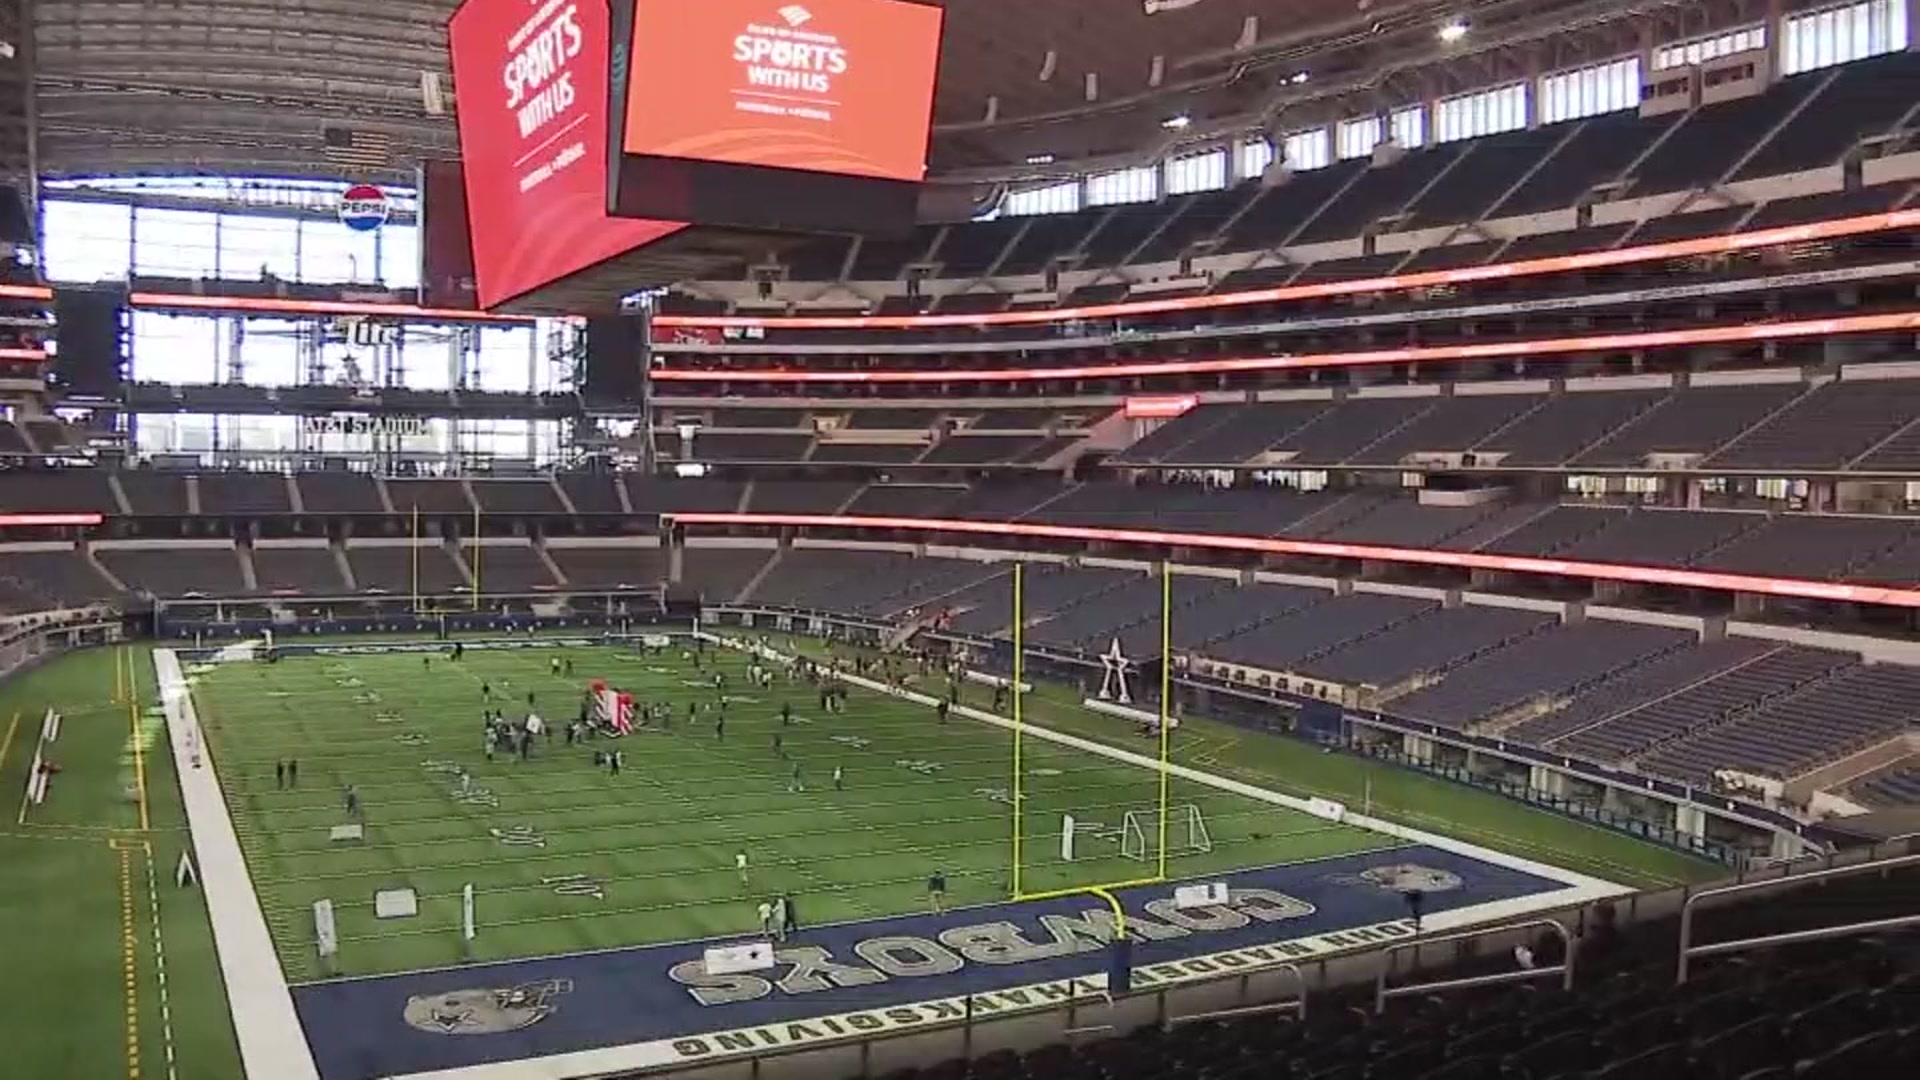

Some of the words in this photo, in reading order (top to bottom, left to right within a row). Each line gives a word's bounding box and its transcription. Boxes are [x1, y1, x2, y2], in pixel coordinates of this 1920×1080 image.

[504, 4, 582, 109] SPORTS
[733, 34, 848, 73] SPORTS
[747, 64, 800, 89] WITH
[801, 71, 829, 93] US
[517, 87, 554, 139] WITH
[551, 71, 575, 113] US
[341, 202, 386, 214] PEPSI
[304, 417, 345, 433] AT&T
[350, 417, 430, 437] STADIUM
[667, 888, 1317, 1006] COWBOYS
